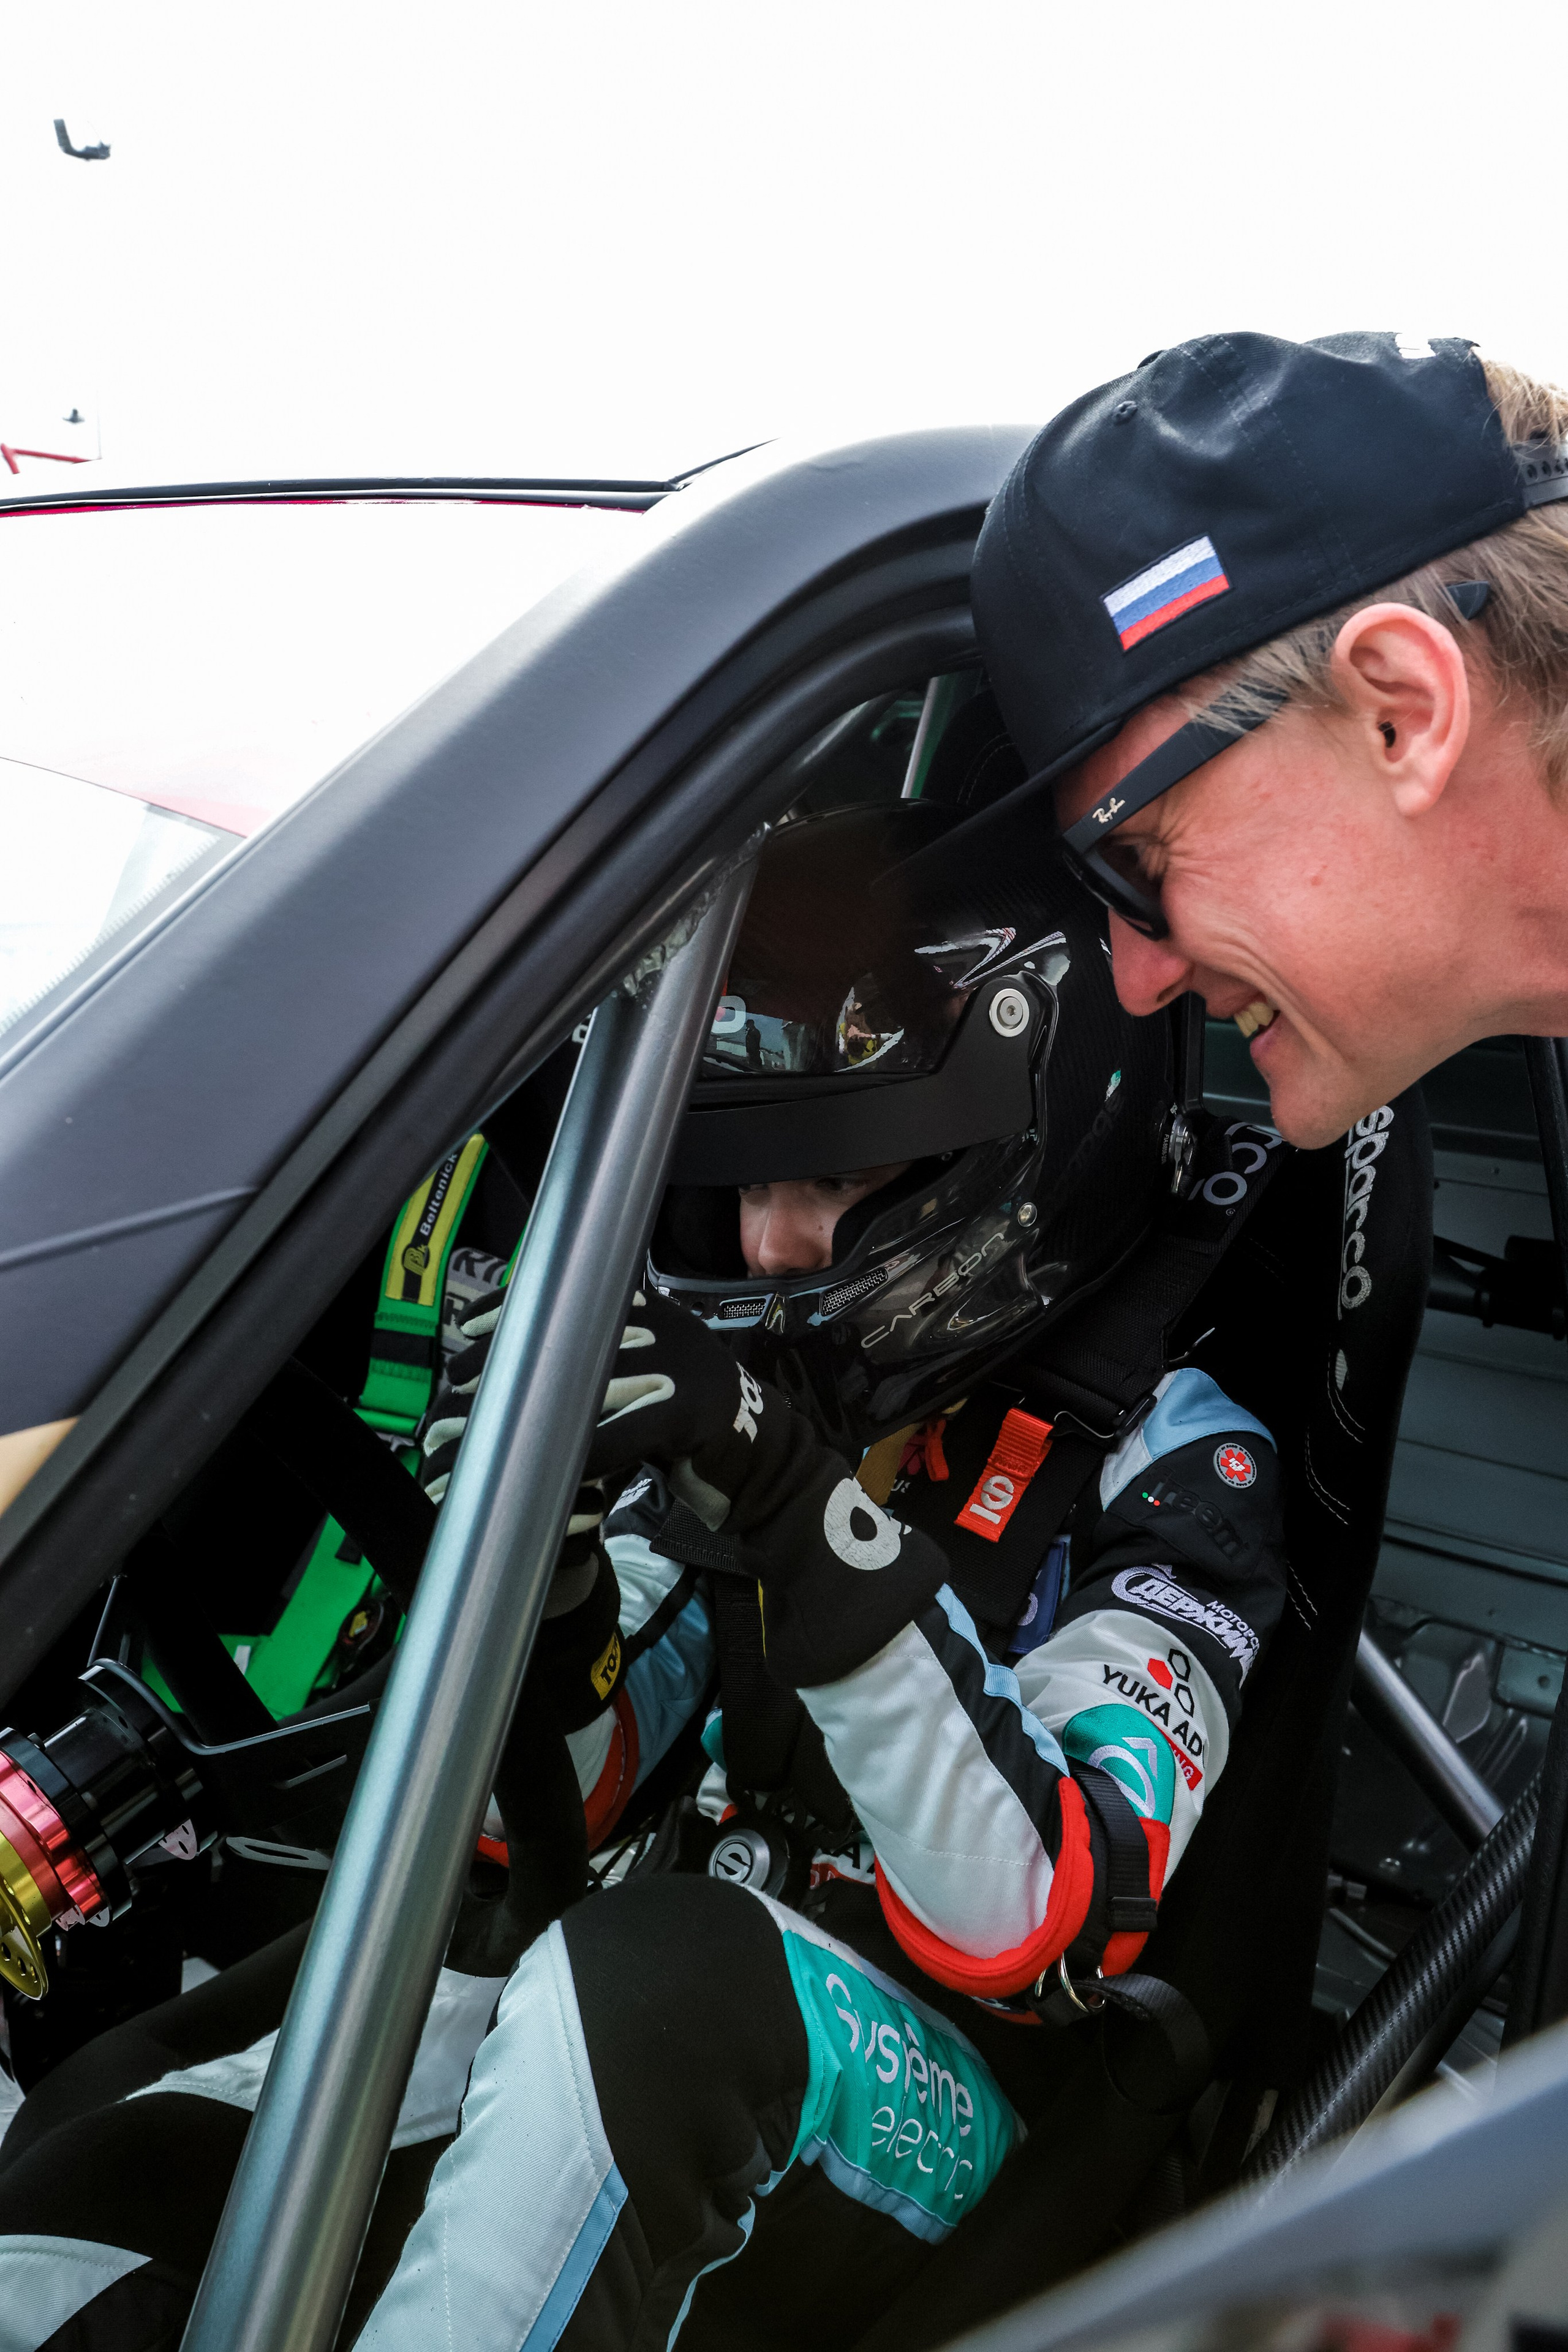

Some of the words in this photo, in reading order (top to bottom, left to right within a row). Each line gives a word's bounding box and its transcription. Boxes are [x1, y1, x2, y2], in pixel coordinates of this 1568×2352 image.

[1343, 1105, 1395, 1310] sparco
[861, 1232, 1005, 1348] CARBON
[1103, 1664, 1170, 1727] YUKA
[1172, 1720, 1204, 1758] AD
